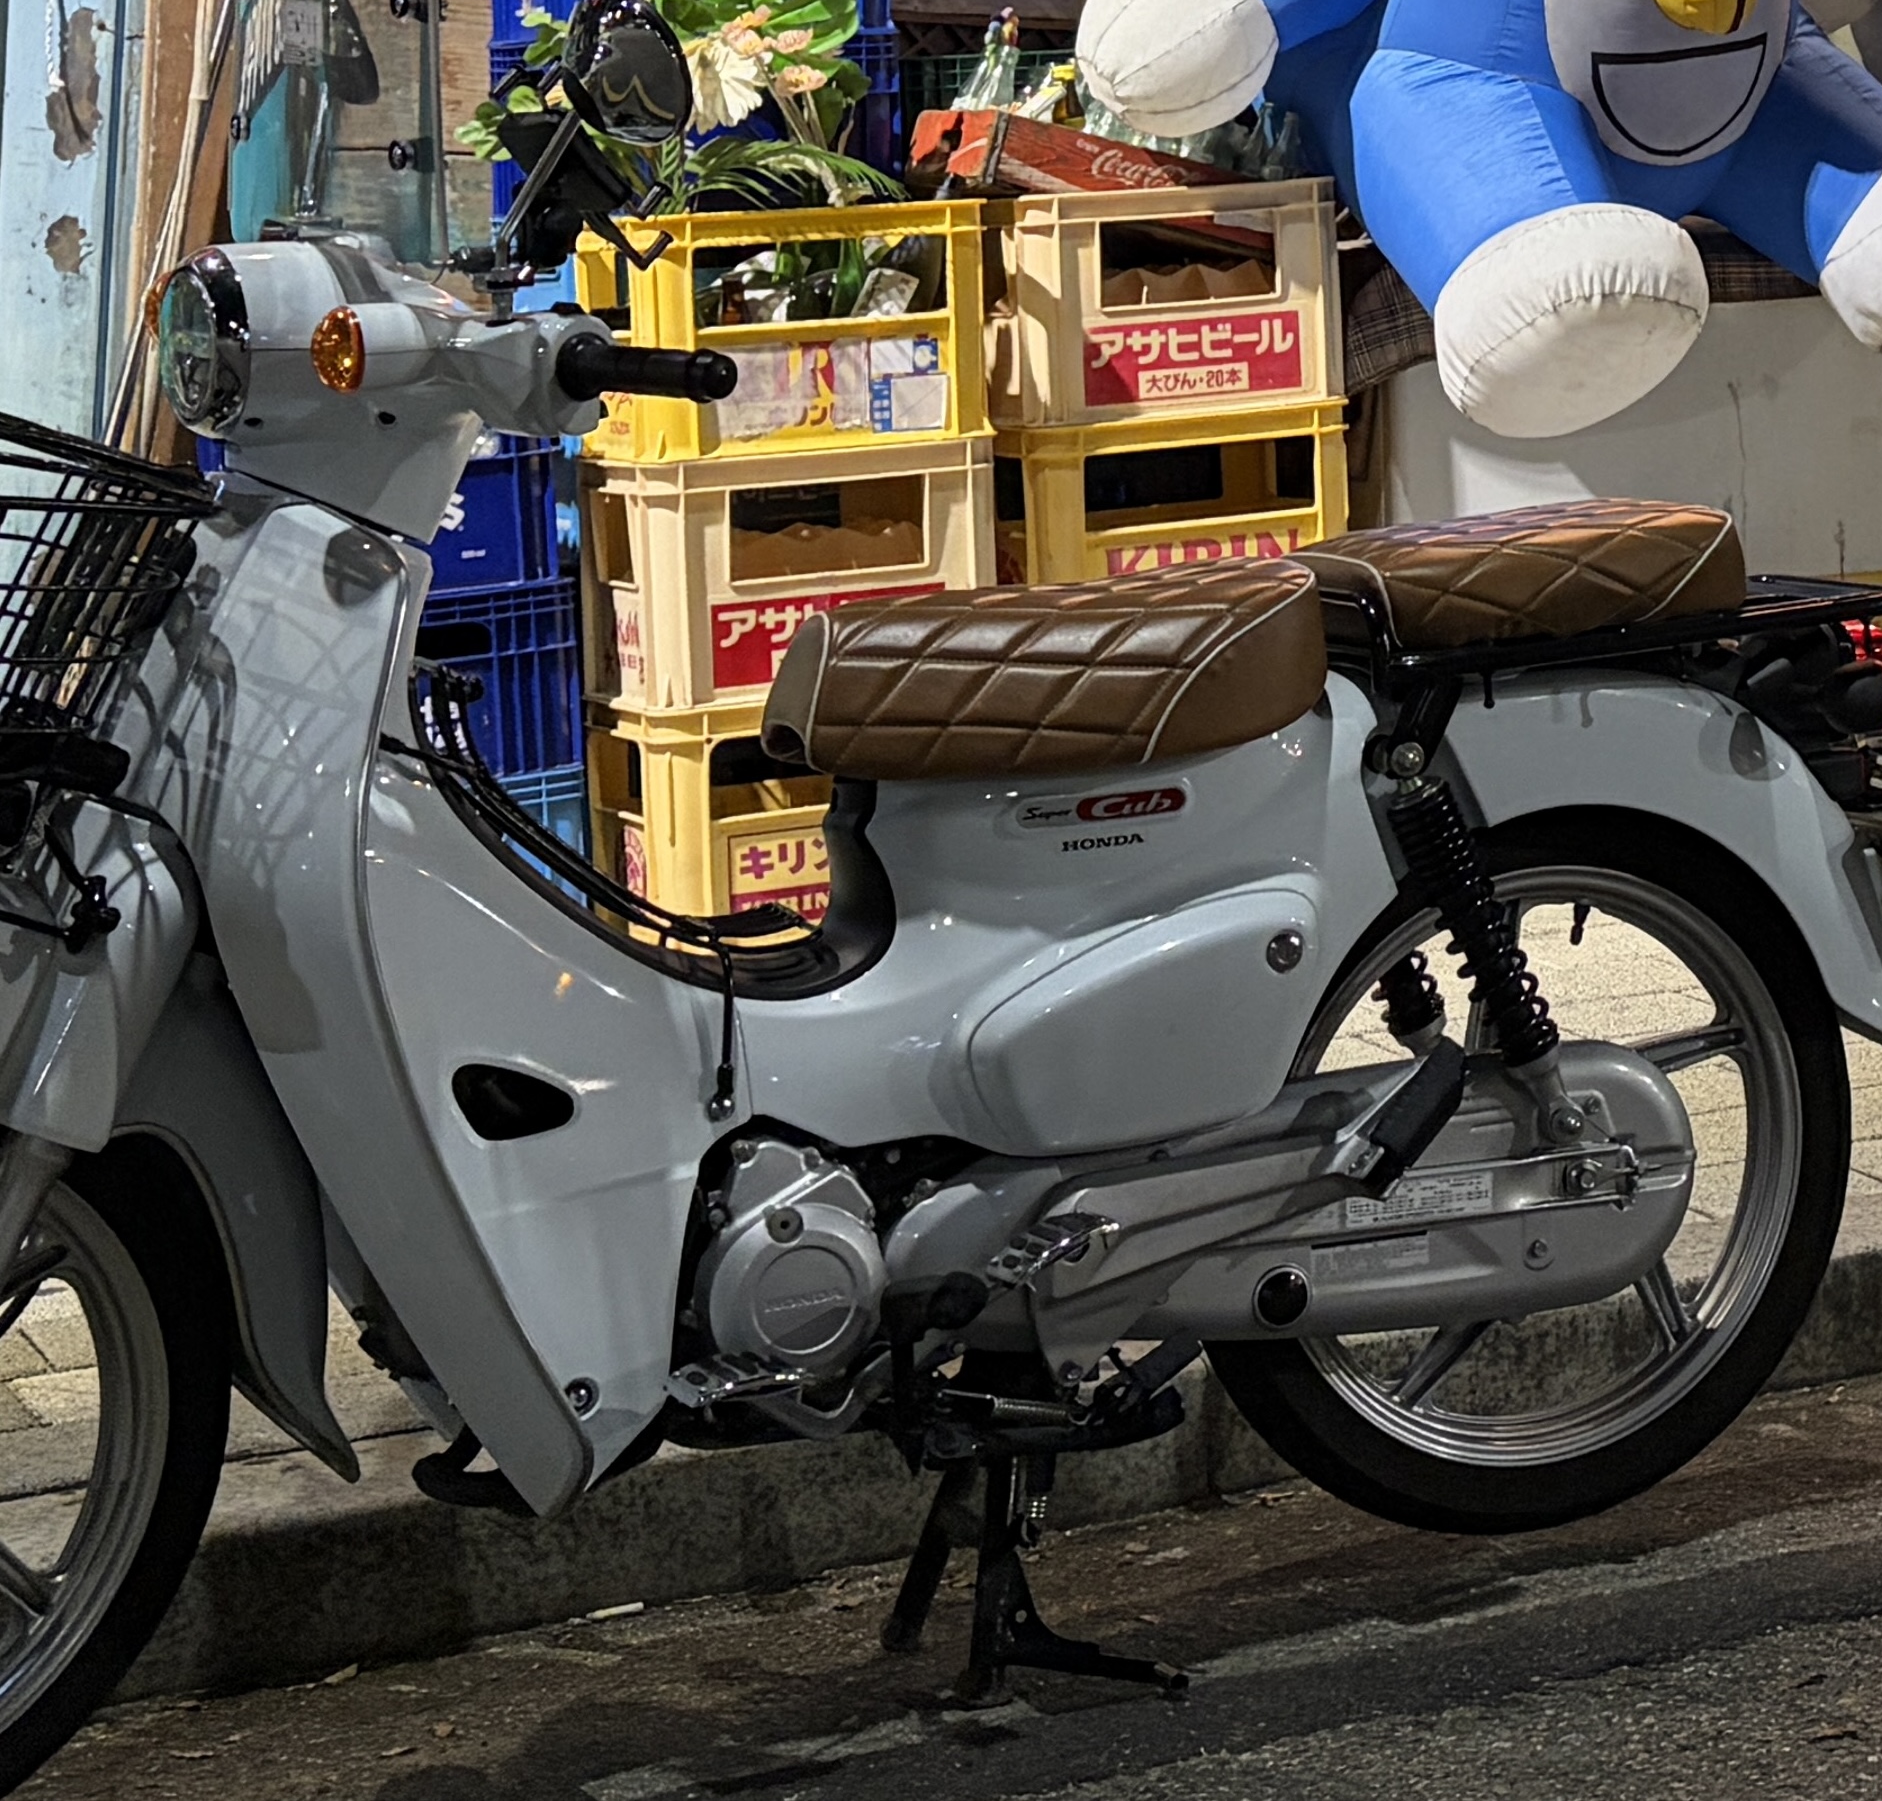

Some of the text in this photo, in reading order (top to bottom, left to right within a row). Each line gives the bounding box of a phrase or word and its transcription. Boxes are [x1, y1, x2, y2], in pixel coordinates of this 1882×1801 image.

[1090, 318, 1294, 369] アサヒビール
[1022, 792, 1172, 821] Super Cub
[1061, 833, 1144, 852] HONDA
